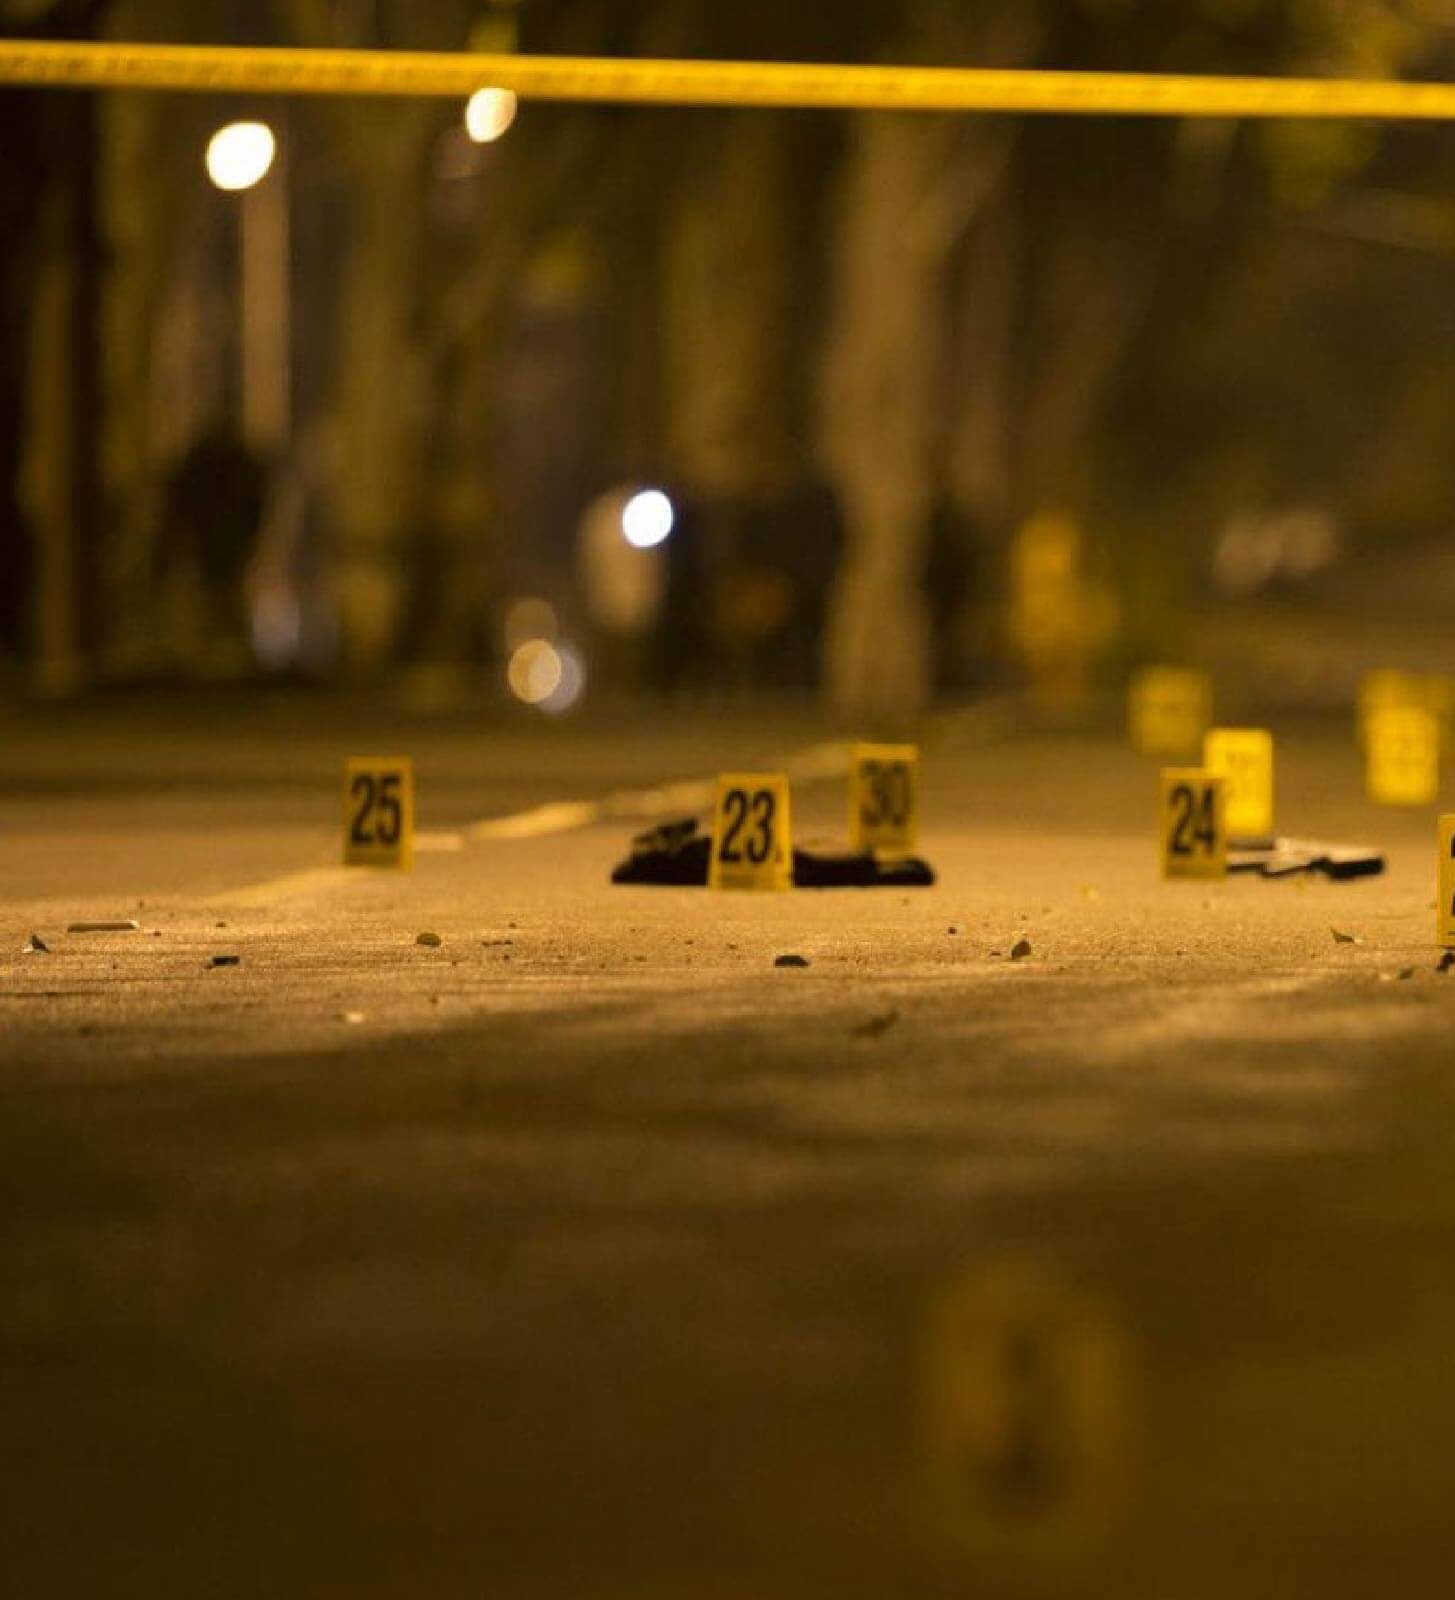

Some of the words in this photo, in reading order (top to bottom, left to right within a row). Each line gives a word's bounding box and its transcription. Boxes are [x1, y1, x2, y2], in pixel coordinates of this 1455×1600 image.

[351, 774, 402, 846] 25
[720, 788, 776, 864] 23
[1170, 782, 1214, 856] 24
